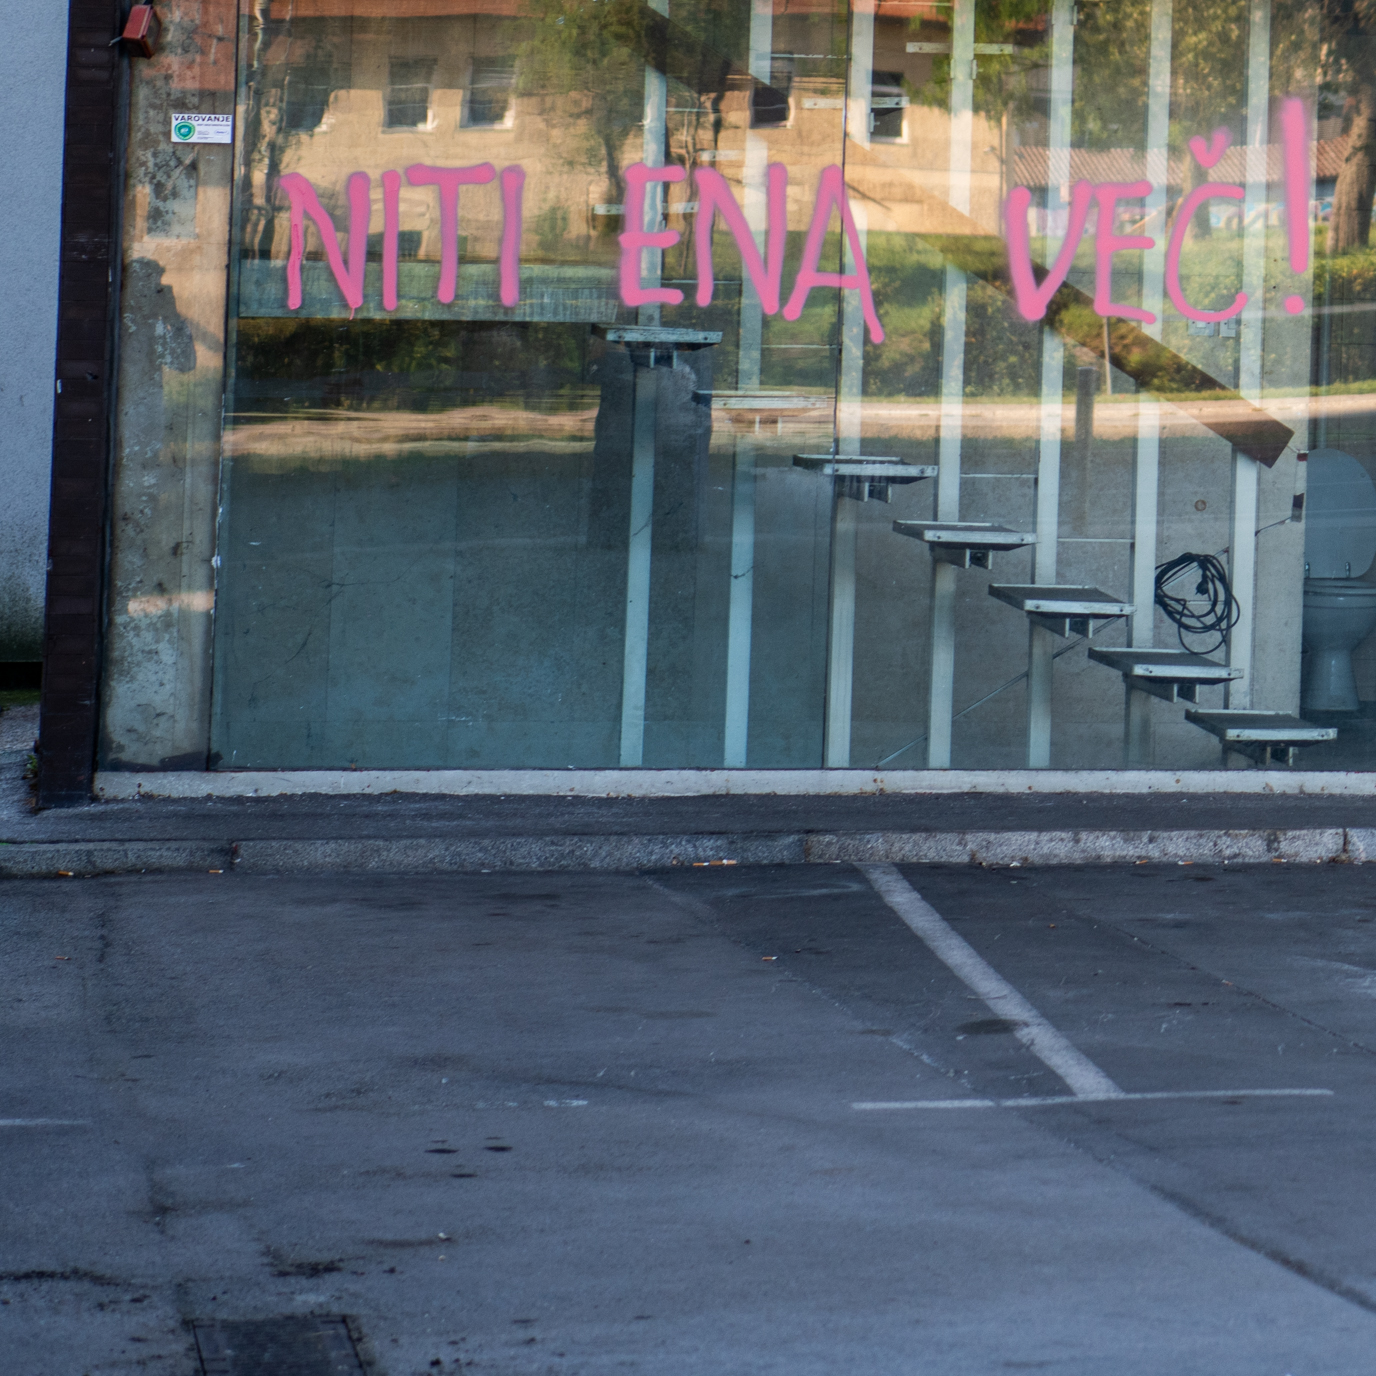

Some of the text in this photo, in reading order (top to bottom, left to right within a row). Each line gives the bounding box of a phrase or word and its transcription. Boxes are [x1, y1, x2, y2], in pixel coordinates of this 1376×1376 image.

[279, 98, 1312, 344] NITI ENA VEČ!
